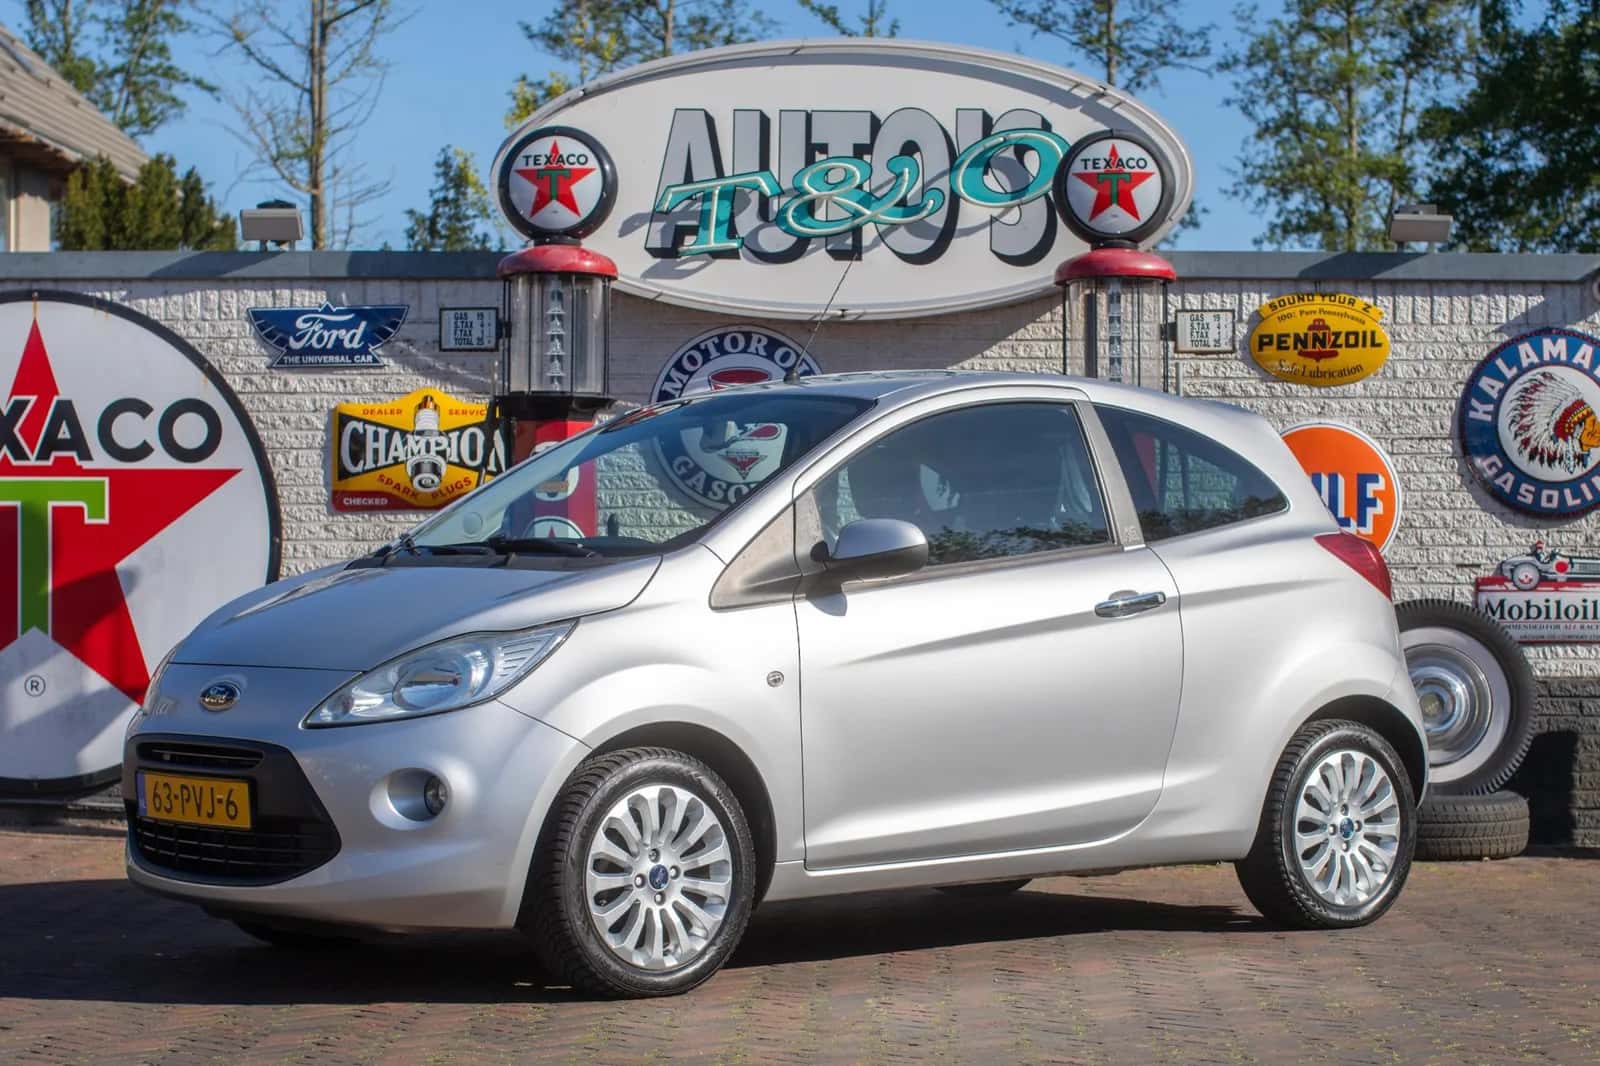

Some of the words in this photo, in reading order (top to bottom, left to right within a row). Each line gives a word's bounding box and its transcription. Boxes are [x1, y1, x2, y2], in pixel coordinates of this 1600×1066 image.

[523, 154, 589, 166] TEXACO
[1081, 158, 1148, 170] TEXACO
[1268, 293, 1315, 312] SOUND
[1320, 293, 1356, 307] YOUR
[454, 312, 468, 321] GAS
[1190, 314, 1204, 322] GAS
[288, 313, 368, 350] Ford
[1258, 331, 1383, 352] PENNZOIL
[284, 356, 300, 364] THE
[302, 355, 351, 364] UNIVERSAL
[353, 354, 373, 363] CAR
[661, 333, 769, 397] MOTOR
[1469, 338, 1600, 422] KALAMA
[448, 409, 487, 417] SERVIC
[0, 397, 223, 463] XACO
[377, 474, 421, 500] SPARK
[431, 476, 472, 499] PLUGS
[1481, 455, 1600, 509] GASOLI
[343, 497, 388, 506] CHECKED
[1485, 598, 1600, 621] Mobiloil
[153, 780, 238, 821] 63-PVJ-6
